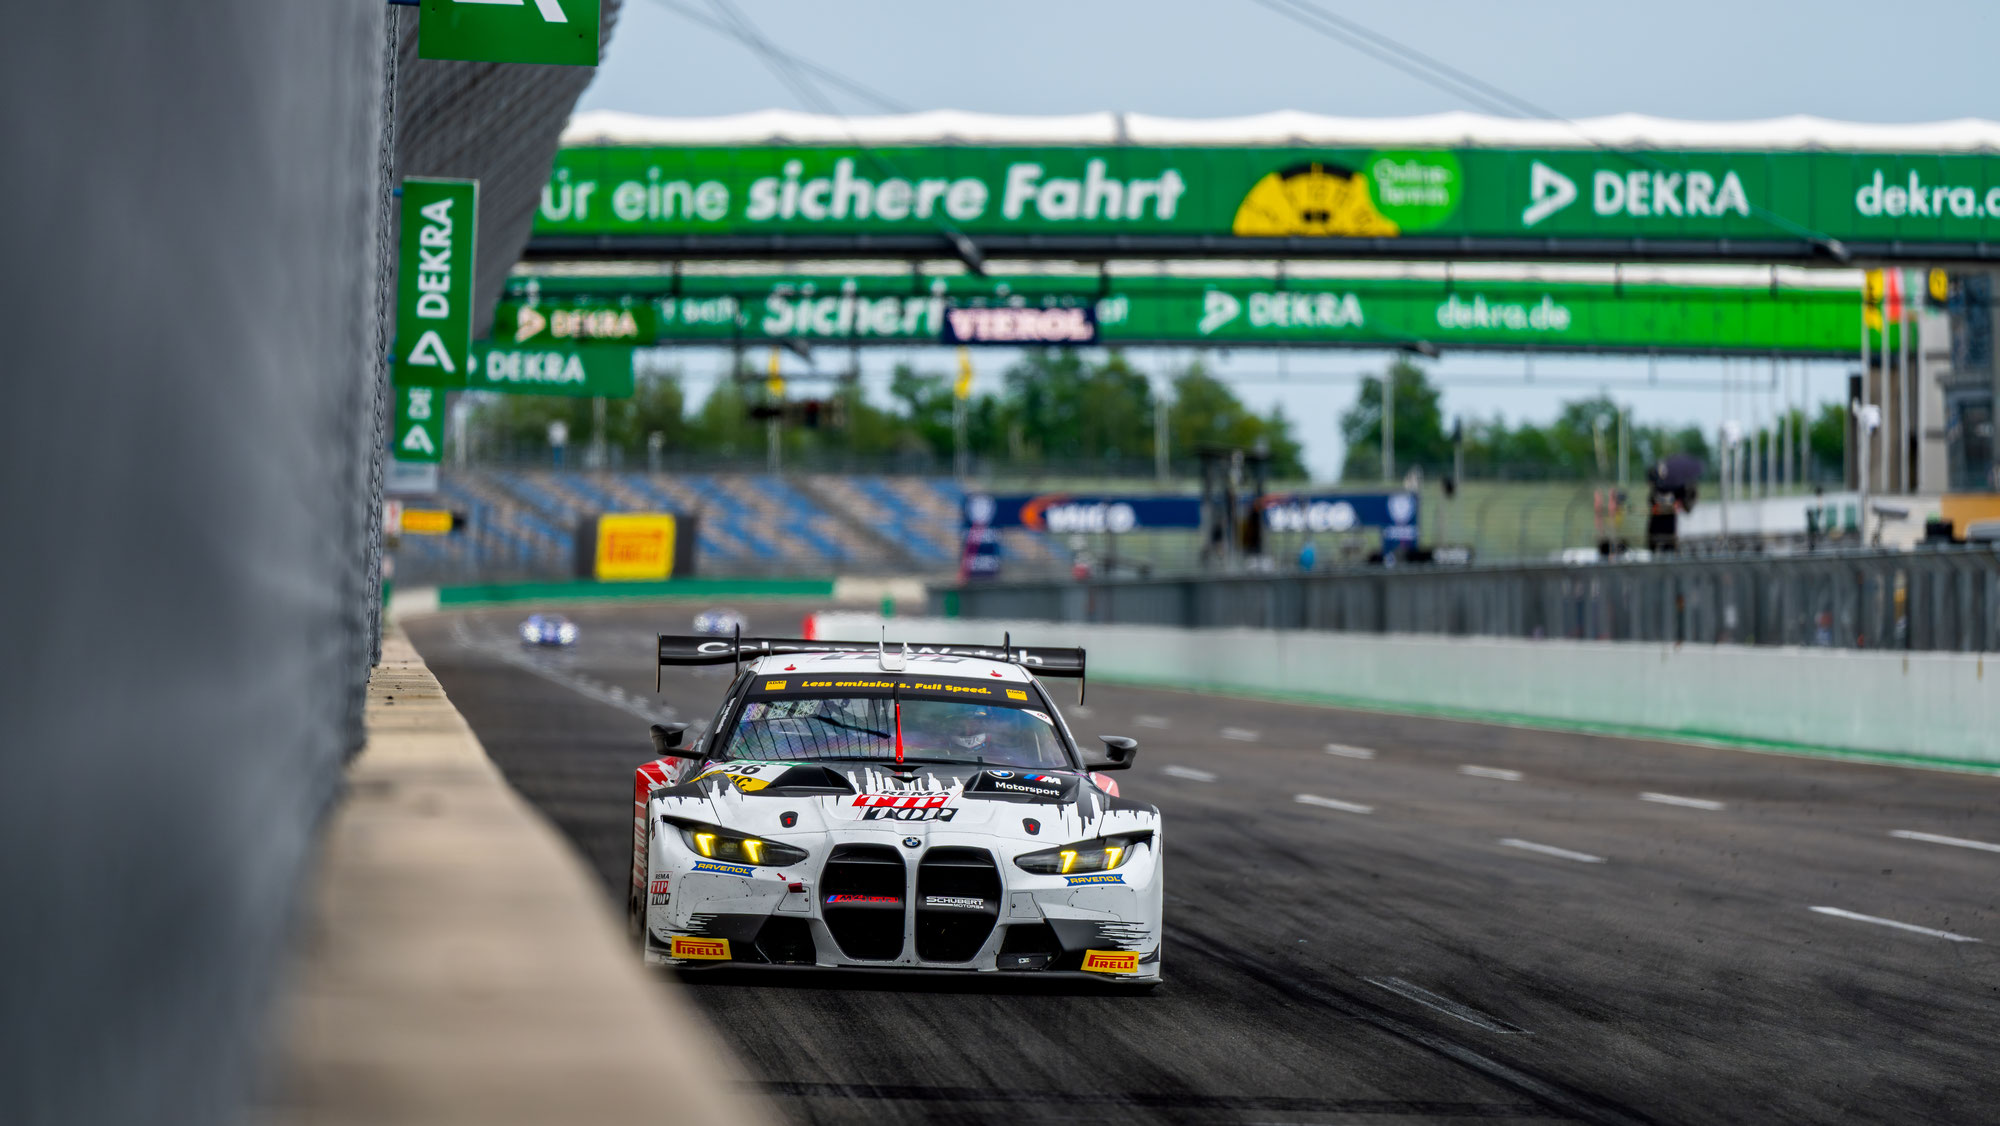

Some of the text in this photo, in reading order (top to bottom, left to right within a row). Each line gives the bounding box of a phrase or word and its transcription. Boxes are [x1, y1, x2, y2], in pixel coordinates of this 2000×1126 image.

[540, 158, 1184, 222] ür eine sichere Fahrt
[1594, 172, 1749, 215] DEKRA
[417, 198, 455, 318] DEKRA
[1248, 292, 1364, 328] DEKRA
[1436, 293, 1571, 330] dekra.de
[550, 308, 640, 339] DEKRA
[486, 351, 587, 384] DEKRA
[802, 680, 833, 688] Less
[914, 682, 942, 690] Full
[945, 684, 992, 695] Speed.
[995, 781, 1060, 797] Motorsport
[697, 863, 751, 875] RAVENOL
[651, 881, 668, 894] TIP
[1070, 876, 1121, 885] RAVENOL
[653, 893, 670, 905] TOP
[926, 896, 984, 905] SCHUBERT
[675, 940, 725, 956] PIRELLI
[1088, 954, 1135, 969] PIRELLI
